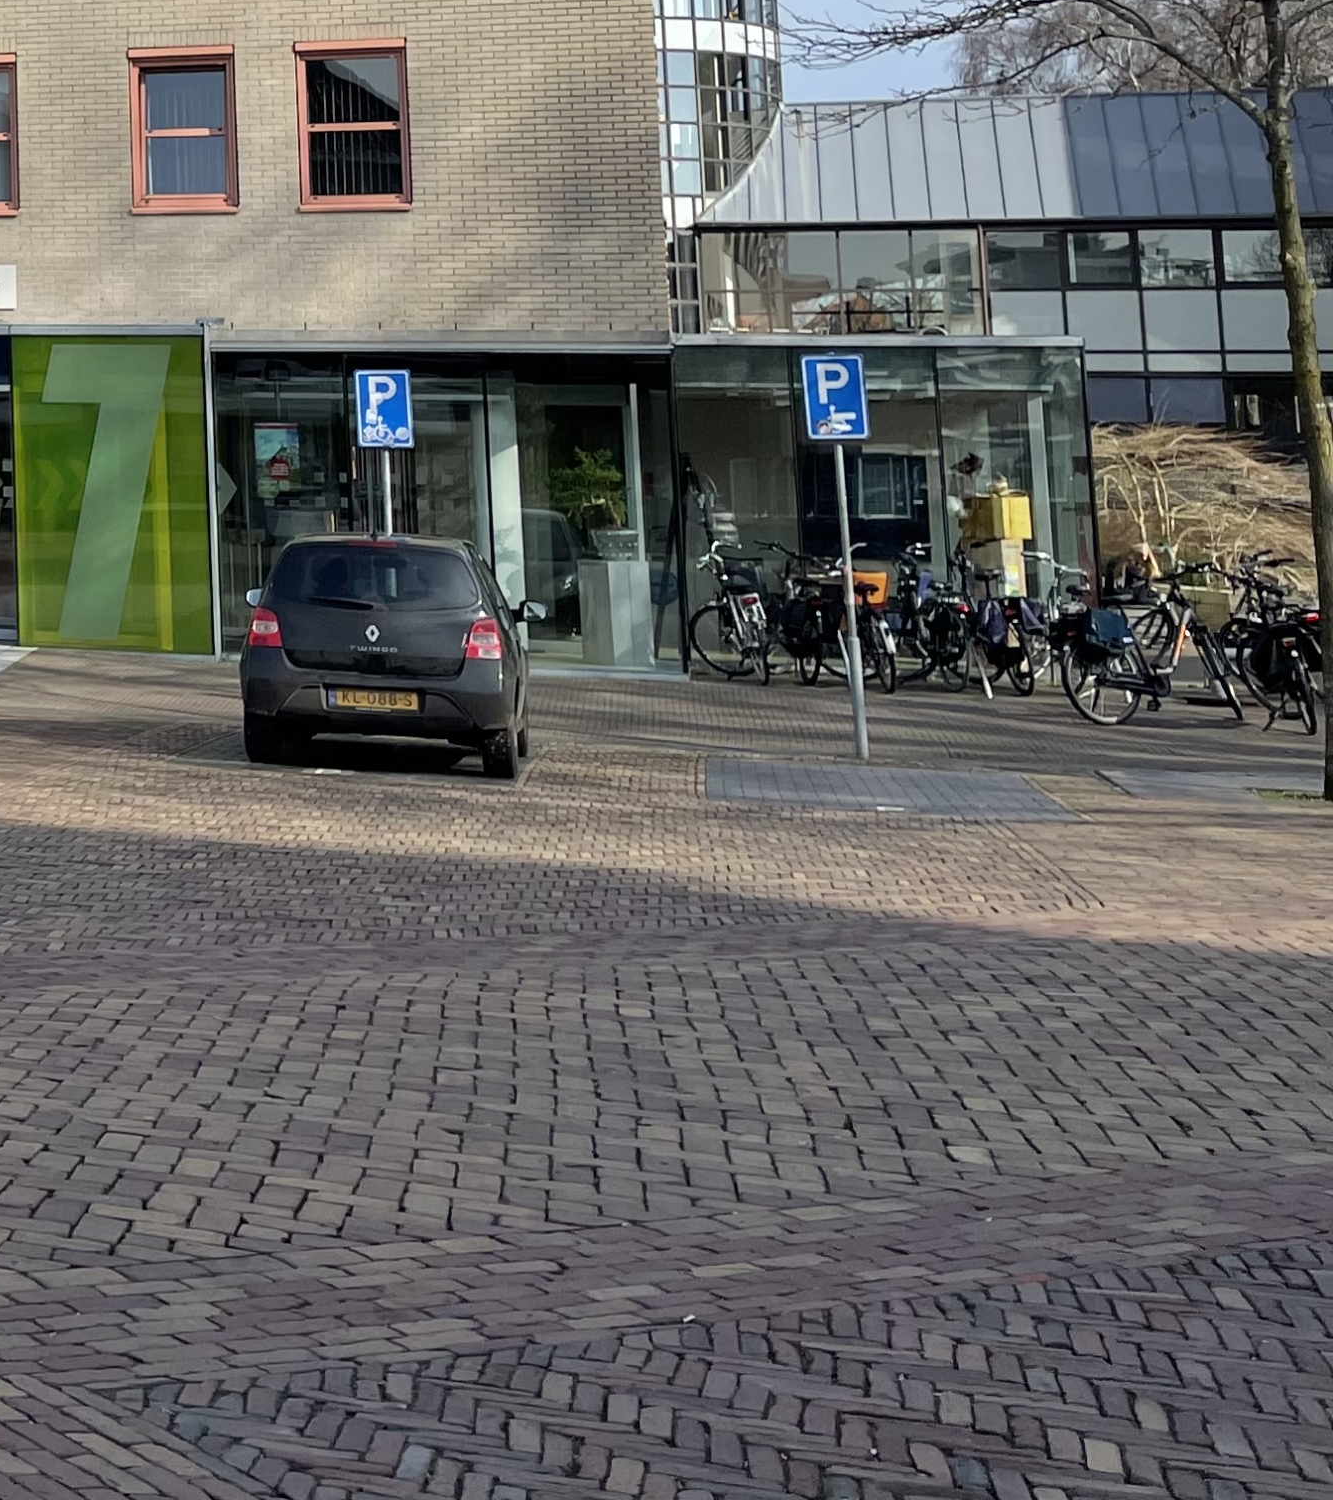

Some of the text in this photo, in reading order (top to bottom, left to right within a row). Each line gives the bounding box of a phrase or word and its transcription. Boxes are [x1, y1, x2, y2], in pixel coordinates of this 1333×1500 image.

[367, 375, 397, 414] P
[816, 362, 850, 405] P
[41, 344, 172, 641] 1
[349, 645, 398, 654] TWINGO
[342, 690, 412, 707] KL-088-S
